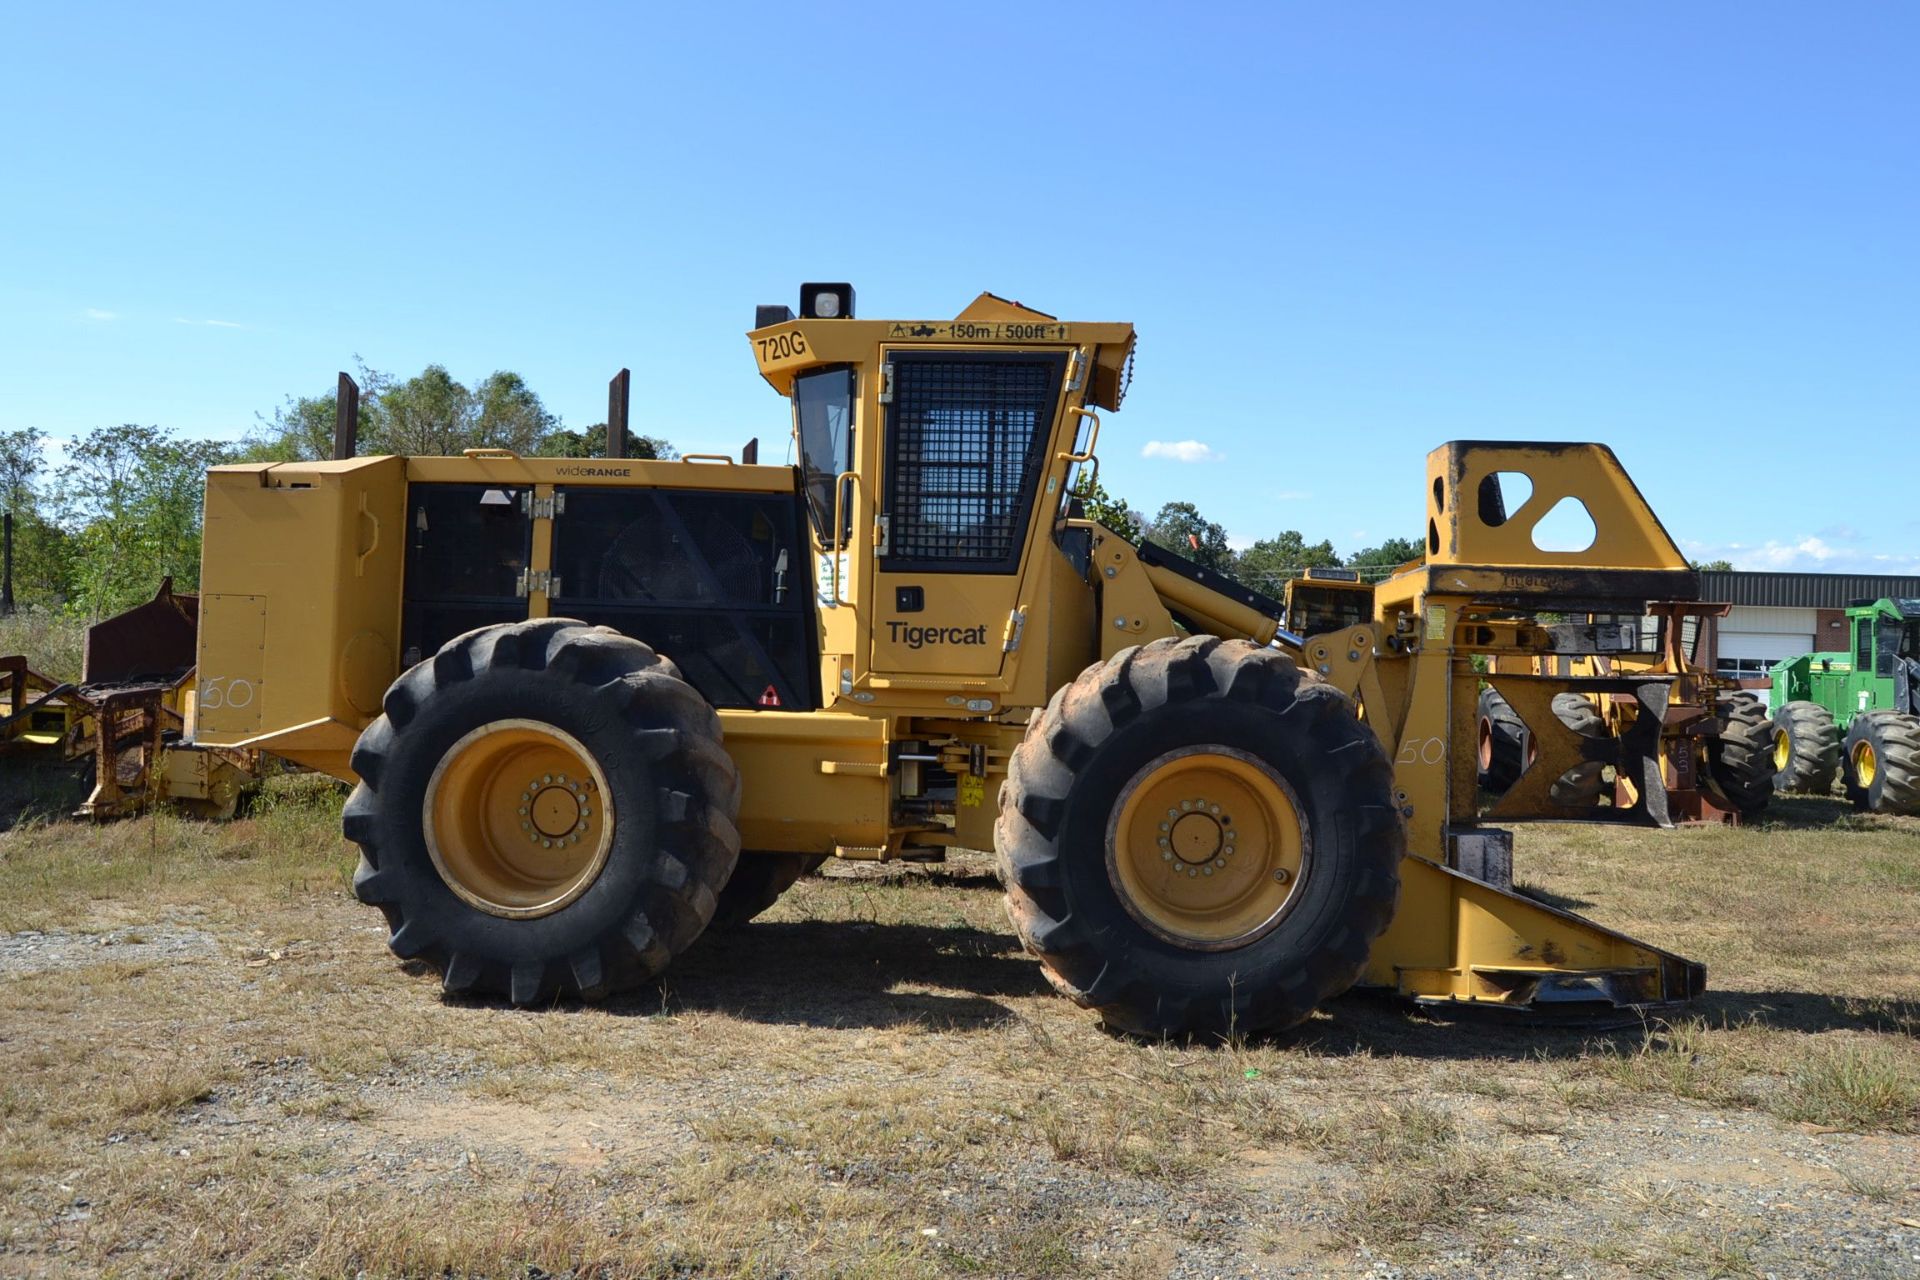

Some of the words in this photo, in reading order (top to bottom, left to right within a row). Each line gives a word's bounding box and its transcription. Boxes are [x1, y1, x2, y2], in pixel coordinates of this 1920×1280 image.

[949, 324, 990, 338] 150m
[1005, 324, 1046, 339] 500ft
[757, 330, 806, 362] 720G
[556, 465, 631, 477] wideRANGE
[886, 621, 986, 649] Tigercat
[200, 676, 253, 709] 50
[1397, 736, 1445, 765] 50
